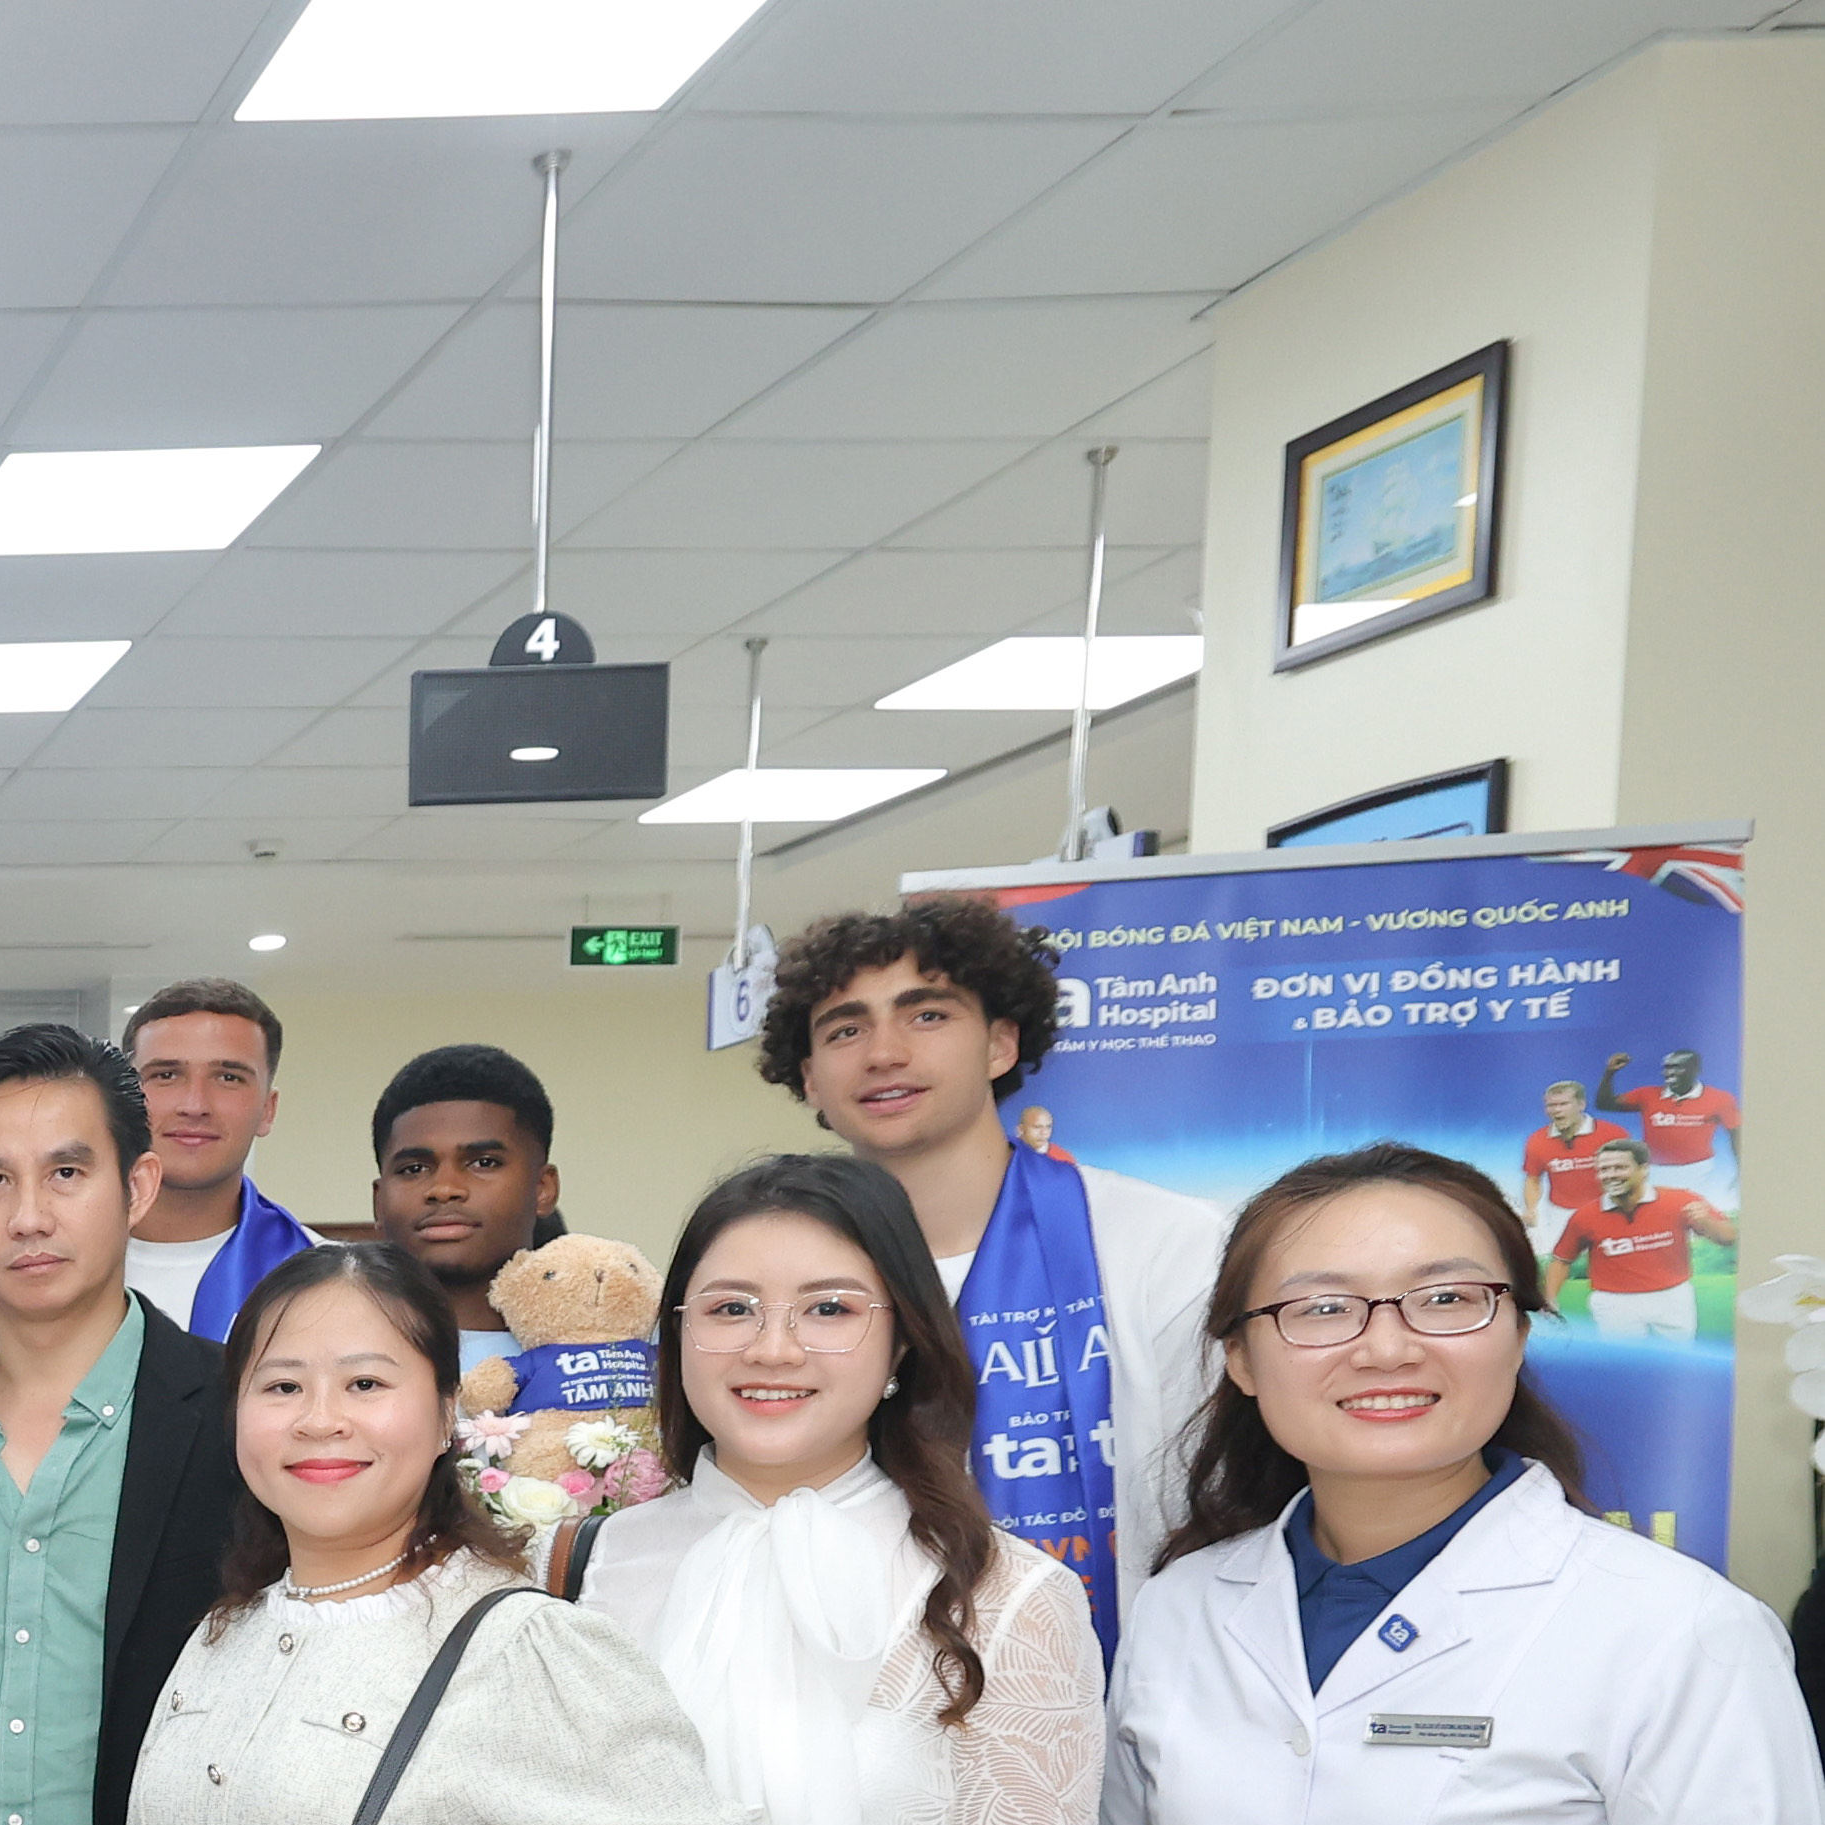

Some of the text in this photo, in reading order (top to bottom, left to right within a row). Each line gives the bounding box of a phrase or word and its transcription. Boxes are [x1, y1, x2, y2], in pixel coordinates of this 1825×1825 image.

[525, 618, 560, 661] 4
[1088, 925, 1166, 949] BÓNG
[1170, 919, 1210, 943] ĐÁ
[1214, 917, 1276, 944] VIỆT
[1280, 915, 1344, 937] NAM
[1364, 907, 1468, 933] VƯƠNG
[1472, 898, 1559, 930] QUỐC
[1562, 899, 1630, 920] ANH
[629, 931, 664, 946] EXIT
[1094, 976, 1156, 999] Tâm
[1157, 971, 1217, 996] Anh
[1251, 958, 1621, 1002] ĐƠN VỊ ĐỒNG HÀNH
[736, 980, 750, 1022] 6
[1098, 998, 1217, 1029] Hospital
[1291, 988, 1576, 1032] & BẢO TRỢ Y TẾ
[969, 1308, 998, 1327] TÀI
[1003, 1306, 1042, 1326] TRỢ
[556, 1351, 600, 1376] ta
[1008, 1409, 1048, 1429] BẢO
[982, 1432, 1062, 1480] ta
[1389, 1621, 1411, 1644] ta
[1370, 1721, 1387, 1735] ta
